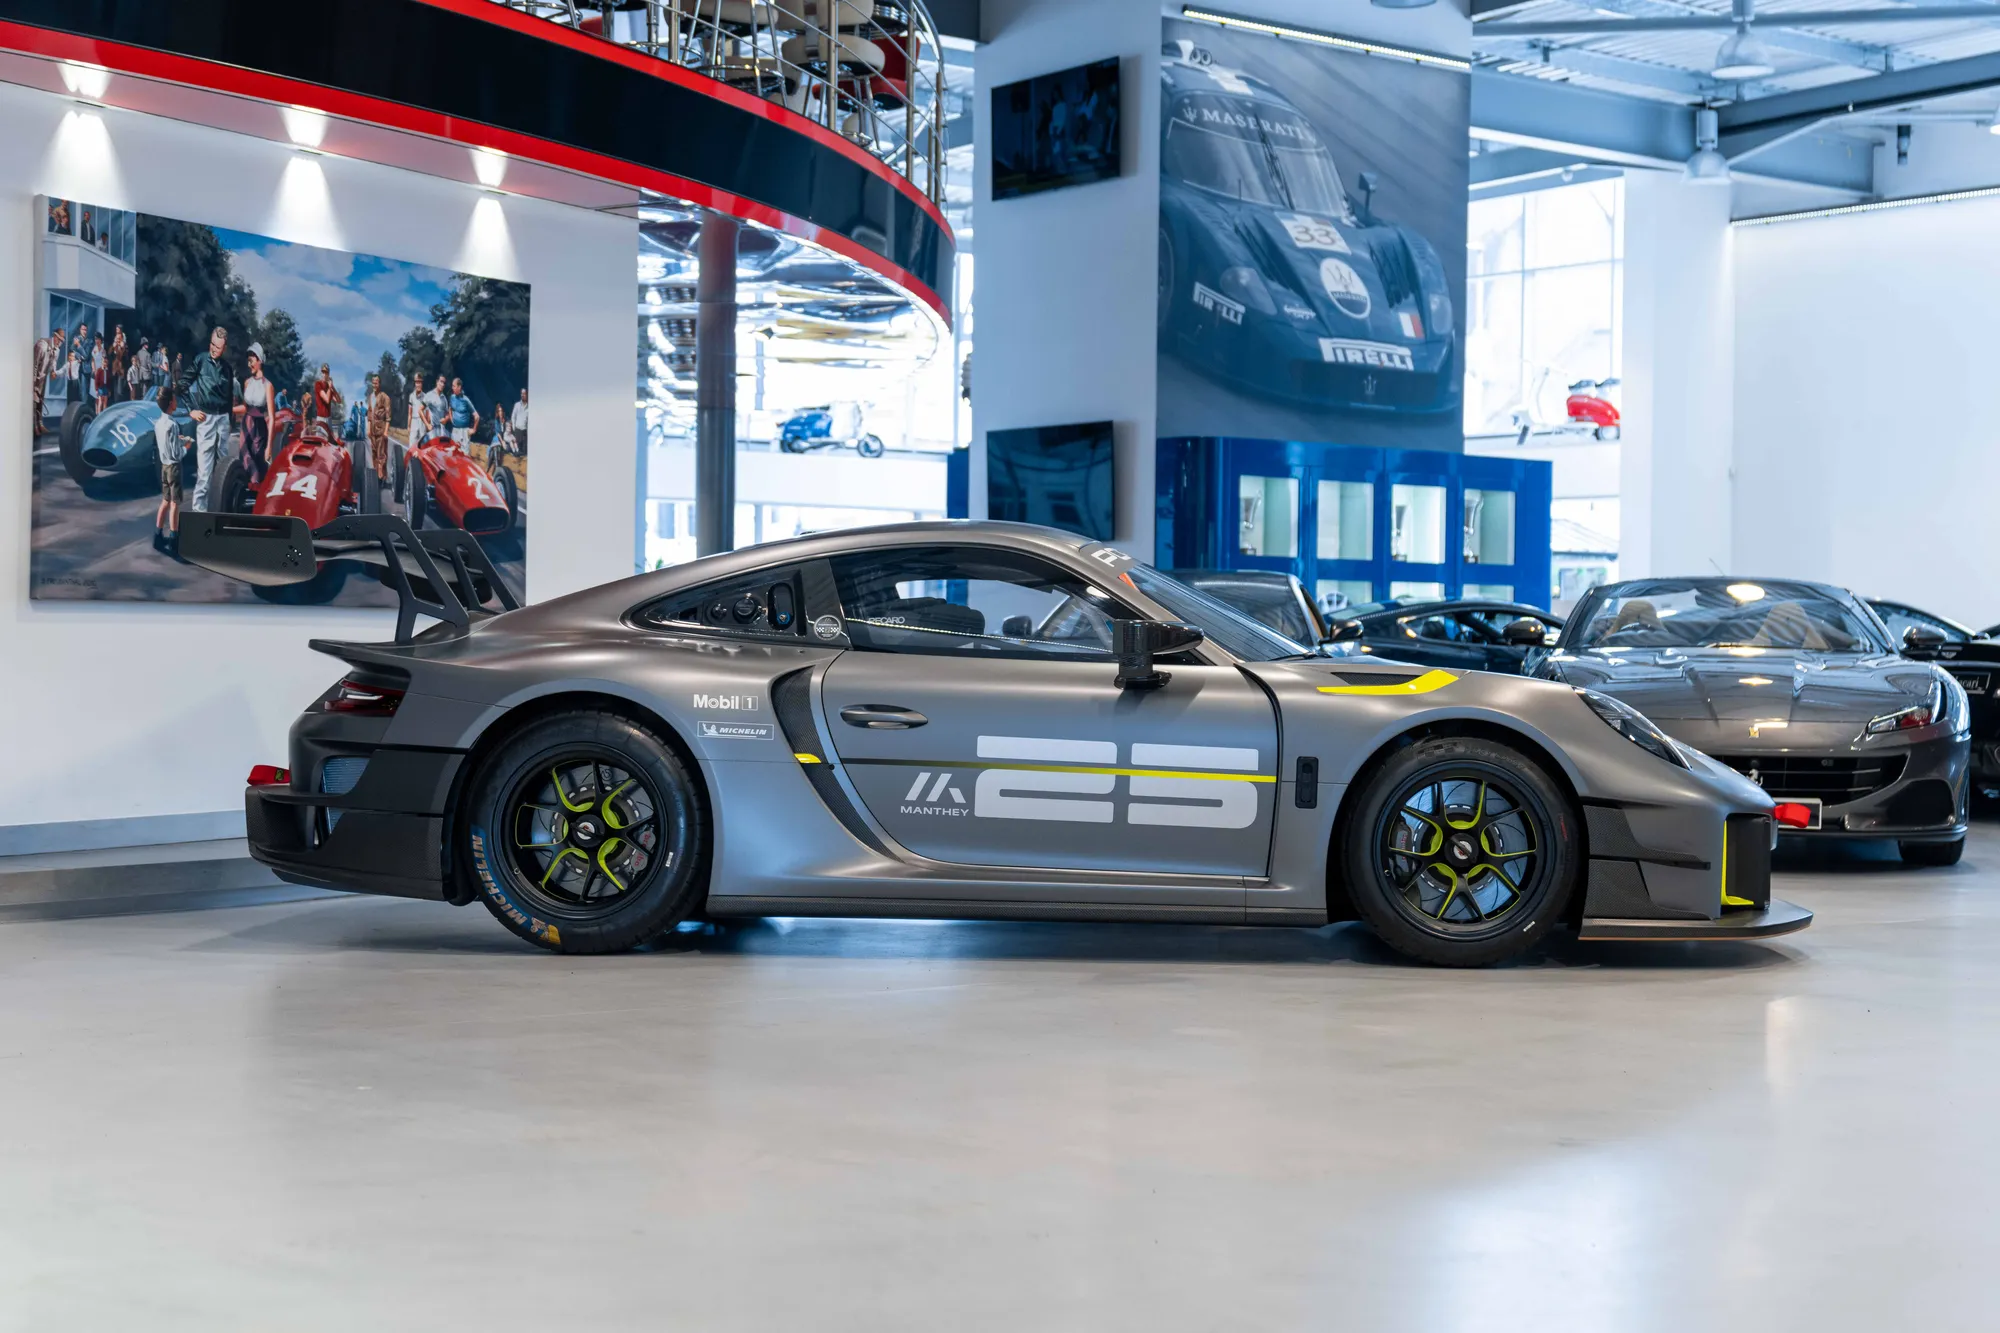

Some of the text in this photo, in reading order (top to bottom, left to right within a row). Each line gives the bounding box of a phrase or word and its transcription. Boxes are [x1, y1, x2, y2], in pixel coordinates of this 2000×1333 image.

[1202, 107, 1314, 142] MASERATI
[1293, 225, 1335, 246] 33
[1193, 281, 1246, 325] PIRLLI
[1318, 337, 1414, 371] PIRELLI
[110, 423, 137, 448] 18
[266, 472, 318, 501] 14
[868, 616, 905, 625] RECARO
[693, 693, 740, 710] Mobil
[719, 727, 767, 736] MICHELIN
[974, 735, 1259, 829] 25
[900, 805, 969, 817] MANTHEY
[472, 834, 528, 925] MICHELIN
